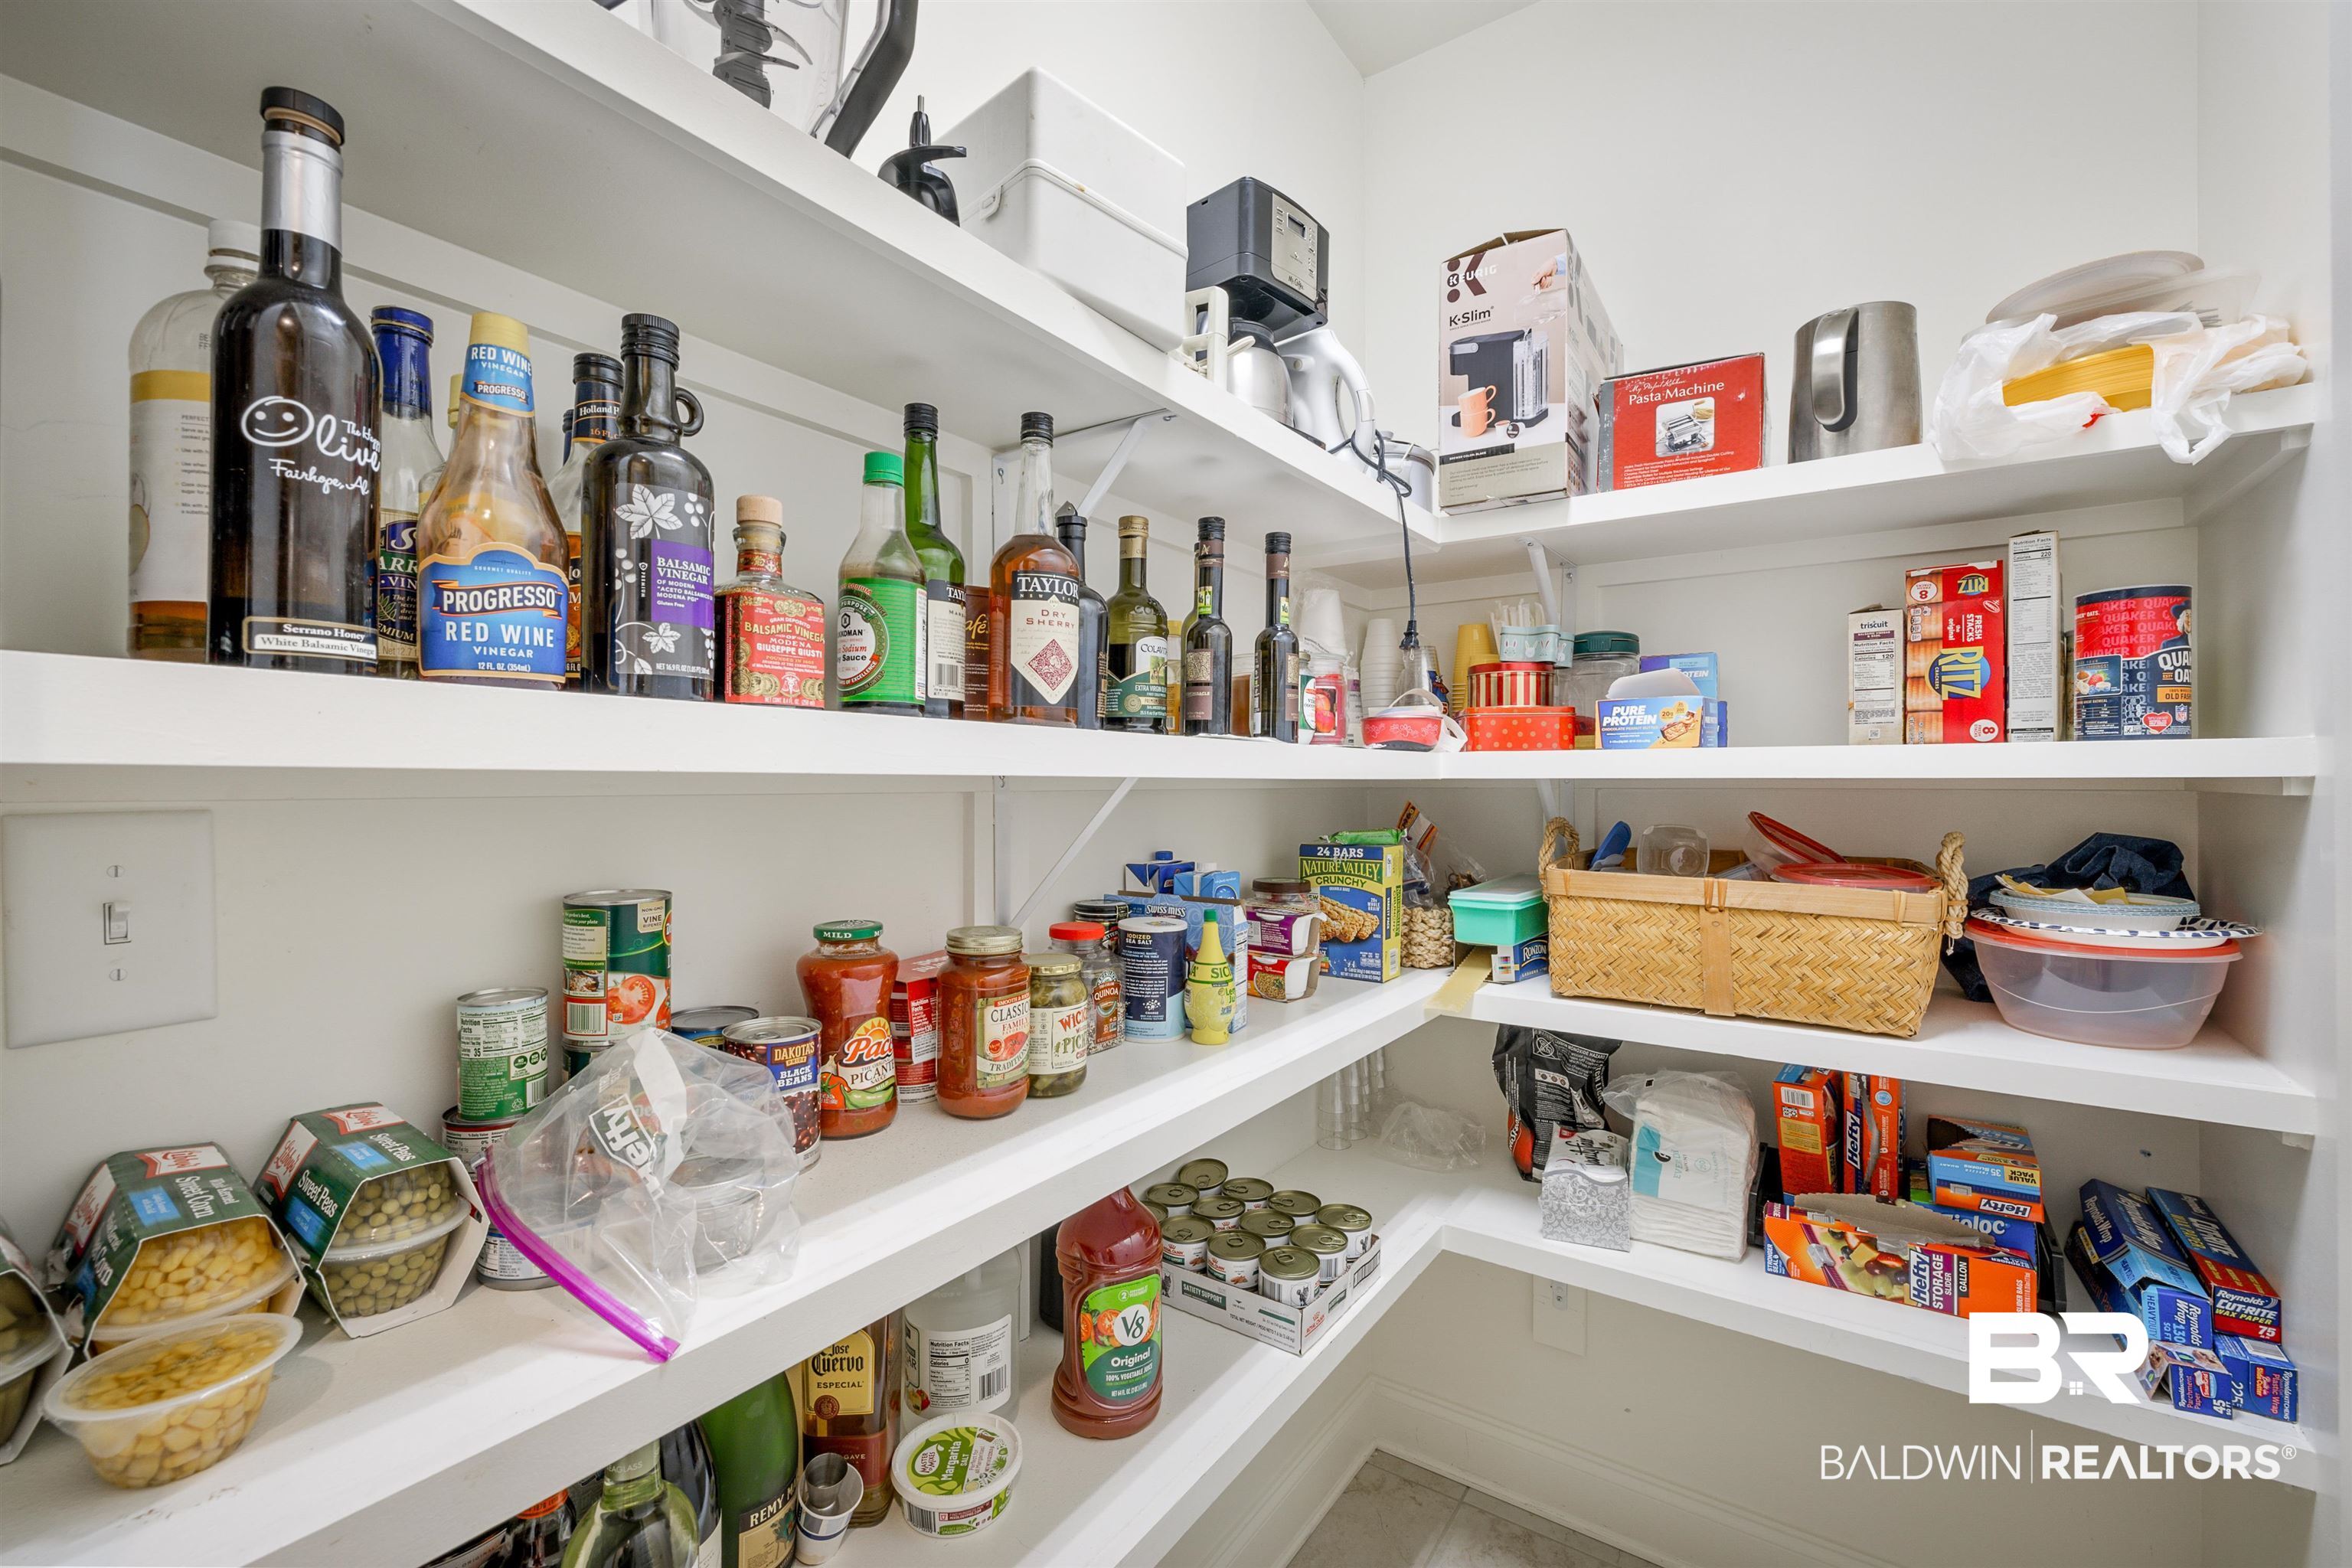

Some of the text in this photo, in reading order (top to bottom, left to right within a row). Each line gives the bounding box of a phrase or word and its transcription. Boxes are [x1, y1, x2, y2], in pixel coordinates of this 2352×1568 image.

[1448, 264, 1498, 287] KEURIG
[471, 346, 533, 376] RED WINE
[481, 361, 525, 379] VINEGAR
[477, 384, 527, 400] PROGRESSO
[1628, 381, 1725, 405] Pasta Machine
[579, 404, 612, 416] Holland
[341, 420, 361, 437] The
[590, 427, 601, 436] 16
[269, 458, 345, 495] Fairhope,
[656, 556, 710, 577] BALSAMIC
[656, 567, 708, 585] VINEGAR
[668, 580, 695, 589] MODENA
[1017, 576, 1079, 599] TAYLOR
[1919, 590, 1929, 599] 8
[1957, 577, 1989, 595] RITZ
[443, 586, 557, 612] PROGRESSO
[656, 592, 686, 600] MODENA
[1040, 609, 1067, 619] DRY
[2102, 612, 2156, 625] QUAKER
[785, 618, 811, 629] DEPOSITO
[1026, 617, 1075, 629] SHERRY
[1860, 620, 1888, 629] triscuit
[1966, 613, 1975, 642] STACKS
[1975, 614, 1983, 640] FRESH
[283, 623, 366, 642] Serrano Honey
[446, 621, 554, 648] RED WINE
[744, 622, 825, 642] BALSAMIC VINEGA
[260, 636, 348, 652] White Balsamic
[769, 638, 812, 648] MODENA
[841, 645, 867, 653] Sodium
[2102, 634, 2156, 648] QUAKER
[472, 645, 534, 658] VINEGAR
[756, 643, 822, 658] GIUSEPPE GIUSTI
[478, 662, 485, 670] 12
[1938, 645, 1984, 701] RITZ
[2165, 692, 2180, 701] OLD
[1612, 704, 1647, 716] PURE
[1602, 714, 1658, 727] PROTEIN
[1982, 726, 1995, 735] 8
[1317, 846, 1364, 858] 24 BARS
[1302, 860, 1380, 880] NATURE VALLEY
[1315, 875, 1367, 888] CRUNCHY
[1145, 903, 1168, 914] SWISS
[642, 914, 662, 923] VINE
[822, 931, 852, 939] MILD
[1522, 944, 1547, 962] RONZONI
[997, 997, 1018, 1006] SMOOTH
[1094, 987, 1119, 1001] QUINOA
[460, 1018, 481, 1026] Nutrition
[473, 1047, 482, 1057] 35
[774, 1041, 815, 1060] DAKOTA'S
[842, 1035, 893, 1064] Pac
[1567, 1044, 1589, 1056] MONOXIDE
[786, 1056, 807, 1067] PRIDE
[777, 1073, 813, 1088] BEANS
[779, 1064, 812, 1080] BLACK
[368, 1132, 416, 1162] Sweet Peas
[1847, 1116, 1859, 1166] Hefty
[2008, 1174, 2037, 1184] VALUE
[2010, 1169, 2035, 1178] PACK
[175, 1175, 215, 1219] Sweet Corn
[297, 1169, 338, 1219] Sweet Peas
[1981, 1198, 2028, 1217] Hefty
[2084, 1195, 2113, 1243] Reynolds Wrap
[1912, 1251, 1930, 1305] Hefty
[1932, 1253, 1944, 1310] STORAGE
[1958, 1261, 1968, 1292] GALLON
[1182, 1283, 1223, 1305] SATIETY SUPPORT
[2216, 1289, 2265, 1306] Reynolds
[2214, 1308, 2272, 1325] WAX PAPER
[2216, 1298, 2278, 1319] CUT-RITE
[1121, 1309, 1145, 1339] V8
[2163, 1321, 2171, 1331] SQ
[2173, 1298, 2188, 1344] Wrap 130
[2189, 1302, 2203, 1347] Reynolds
[2258, 1325, 2277, 1338] 75
[812, 1354, 864, 1377] Cuervo
[1110, 1347, 1151, 1367] Original
[1106, 1367, 1143, 1382] 100% VEGETABLE
[816, 1380, 864, 1389] ESPECIAL
[2194, 1392, 2202, 1410] Paper
[2270, 1373, 2281, 1415] Plastic Wrap
[2212, 1399, 2227, 1415] 45
[920, 1452, 930, 1474] MASTER
[940, 1440, 962, 1481] Margarita
[960, 1453, 969, 1467] SALT
[750, 1501, 785, 1528] REMY
